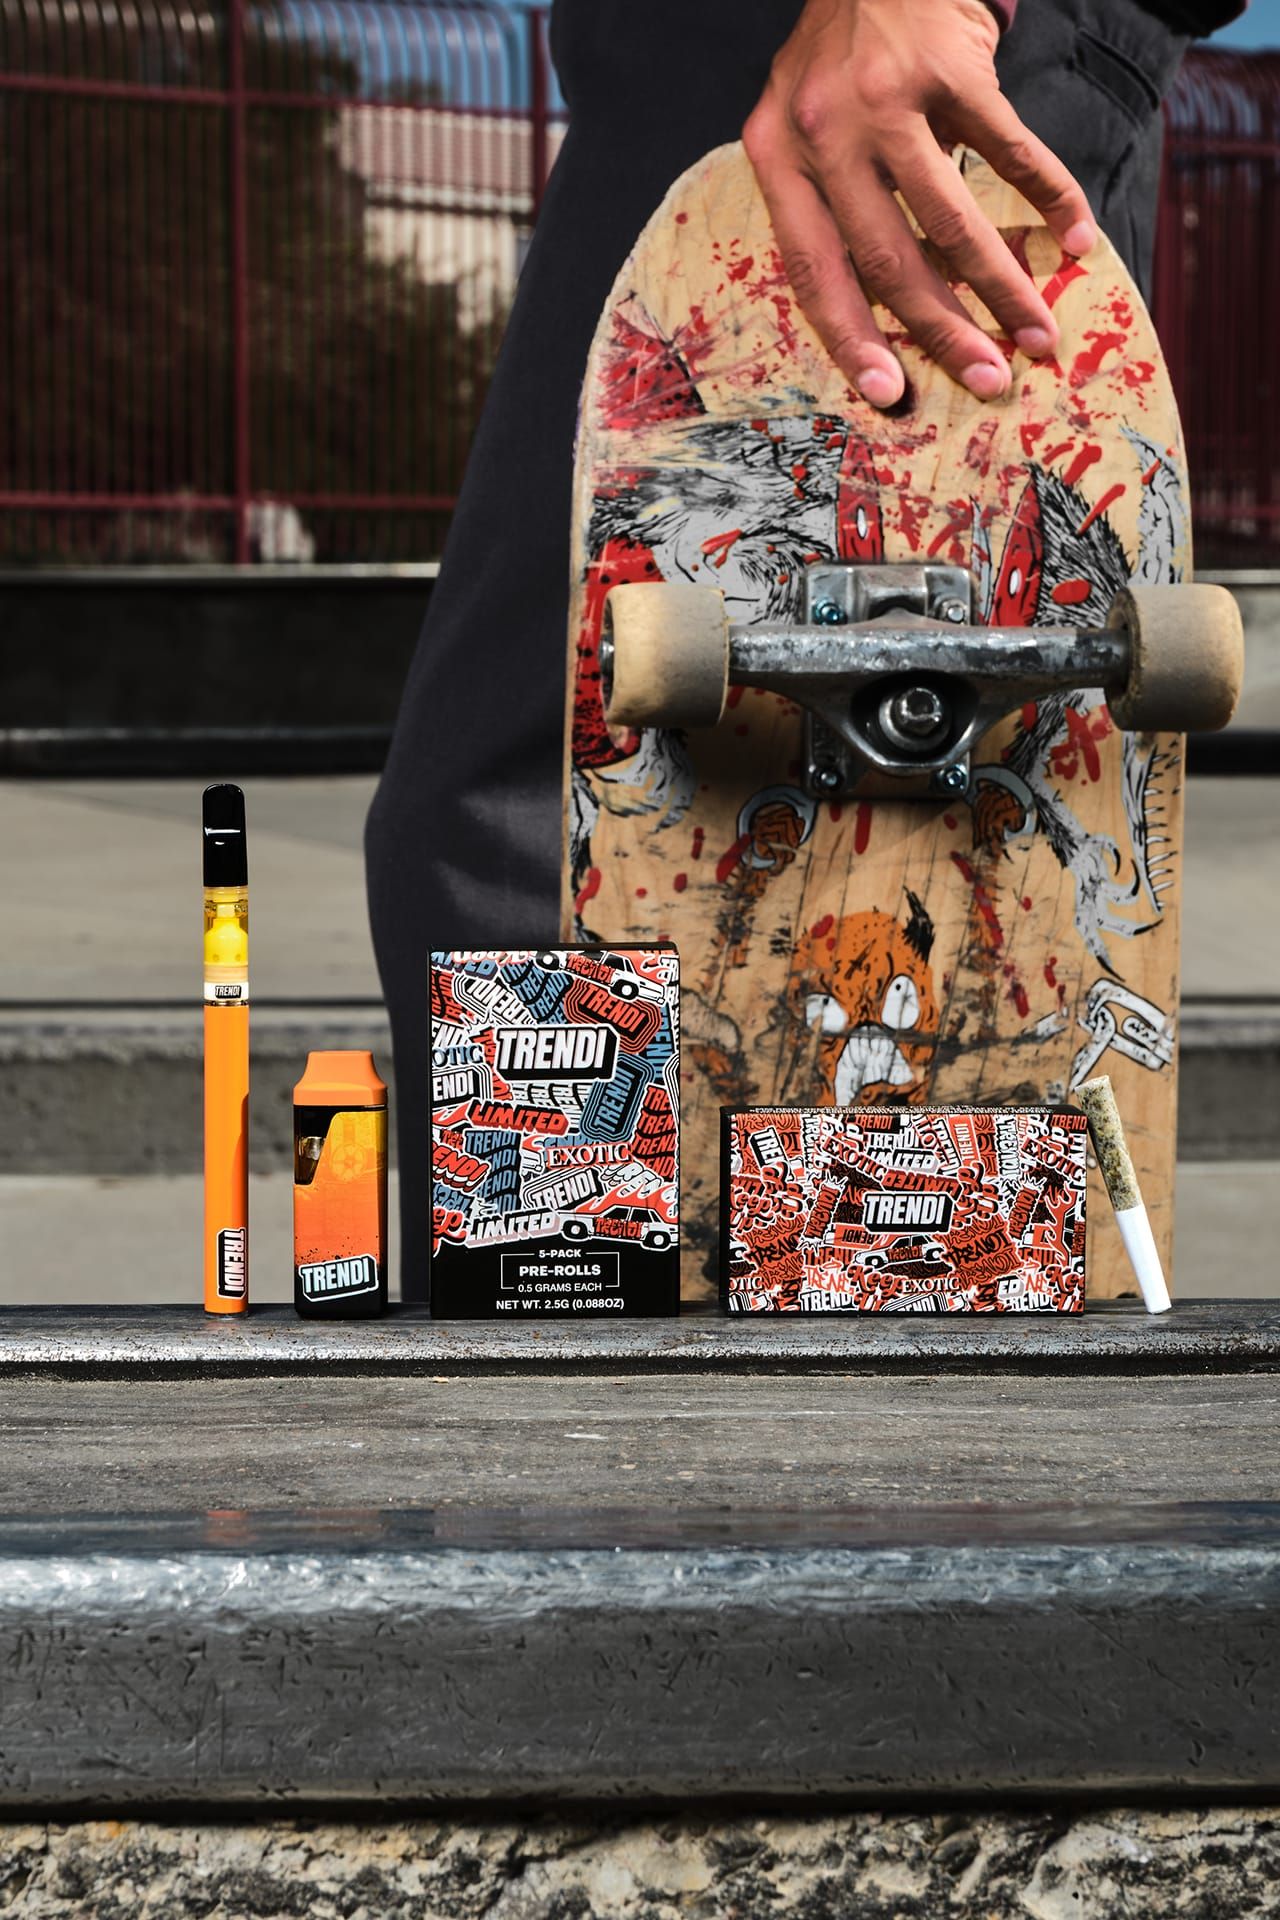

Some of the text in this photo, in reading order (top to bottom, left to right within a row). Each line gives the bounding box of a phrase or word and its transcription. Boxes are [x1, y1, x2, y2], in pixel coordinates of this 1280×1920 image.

[215, 986, 240, 996] TRENDI
[580, 983, 647, 1032] TRENDI
[499, 1029, 608, 1069] TRENDI
[593, 1067, 635, 1132] TRENDI
[471, 1104, 568, 1131] LIMITED
[466, 1131, 517, 1155] TRENDI
[549, 1144, 630, 1167] EXOTIC
[954, 1123, 975, 1160] TRENDI
[999, 1119, 1020, 1176] TRENDI
[823, 1136, 887, 1180] EXOTIC
[1021, 1137, 1086, 1182] EXOTIC
[531, 1168, 597, 1212] TRENDI
[881, 1170, 960, 1198] LIMITED
[804, 1185, 838, 1238] TRENDI
[866, 1196, 946, 1224] TRENDI
[1008, 1188, 1037, 1239] TRENDI
[467, 1212, 556, 1241] LIMITED
[595, 1217, 643, 1238] TRENDI
[224, 1230, 244, 1292] TRENDI
[538, 1249, 582, 1259] 5-PACK
[302, 1257, 370, 1293] TRENDI
[519, 1264, 602, 1277] PRE-ROLLS
[518, 1282, 602, 1293] 0.5 GRAMS EACH
[902, 1278, 961, 1293] EXOTIC
[496, 1300, 519, 1310] NET
[521, 1299, 542, 1310] WT.
[544, 1299, 570, 1309] 2.5G
